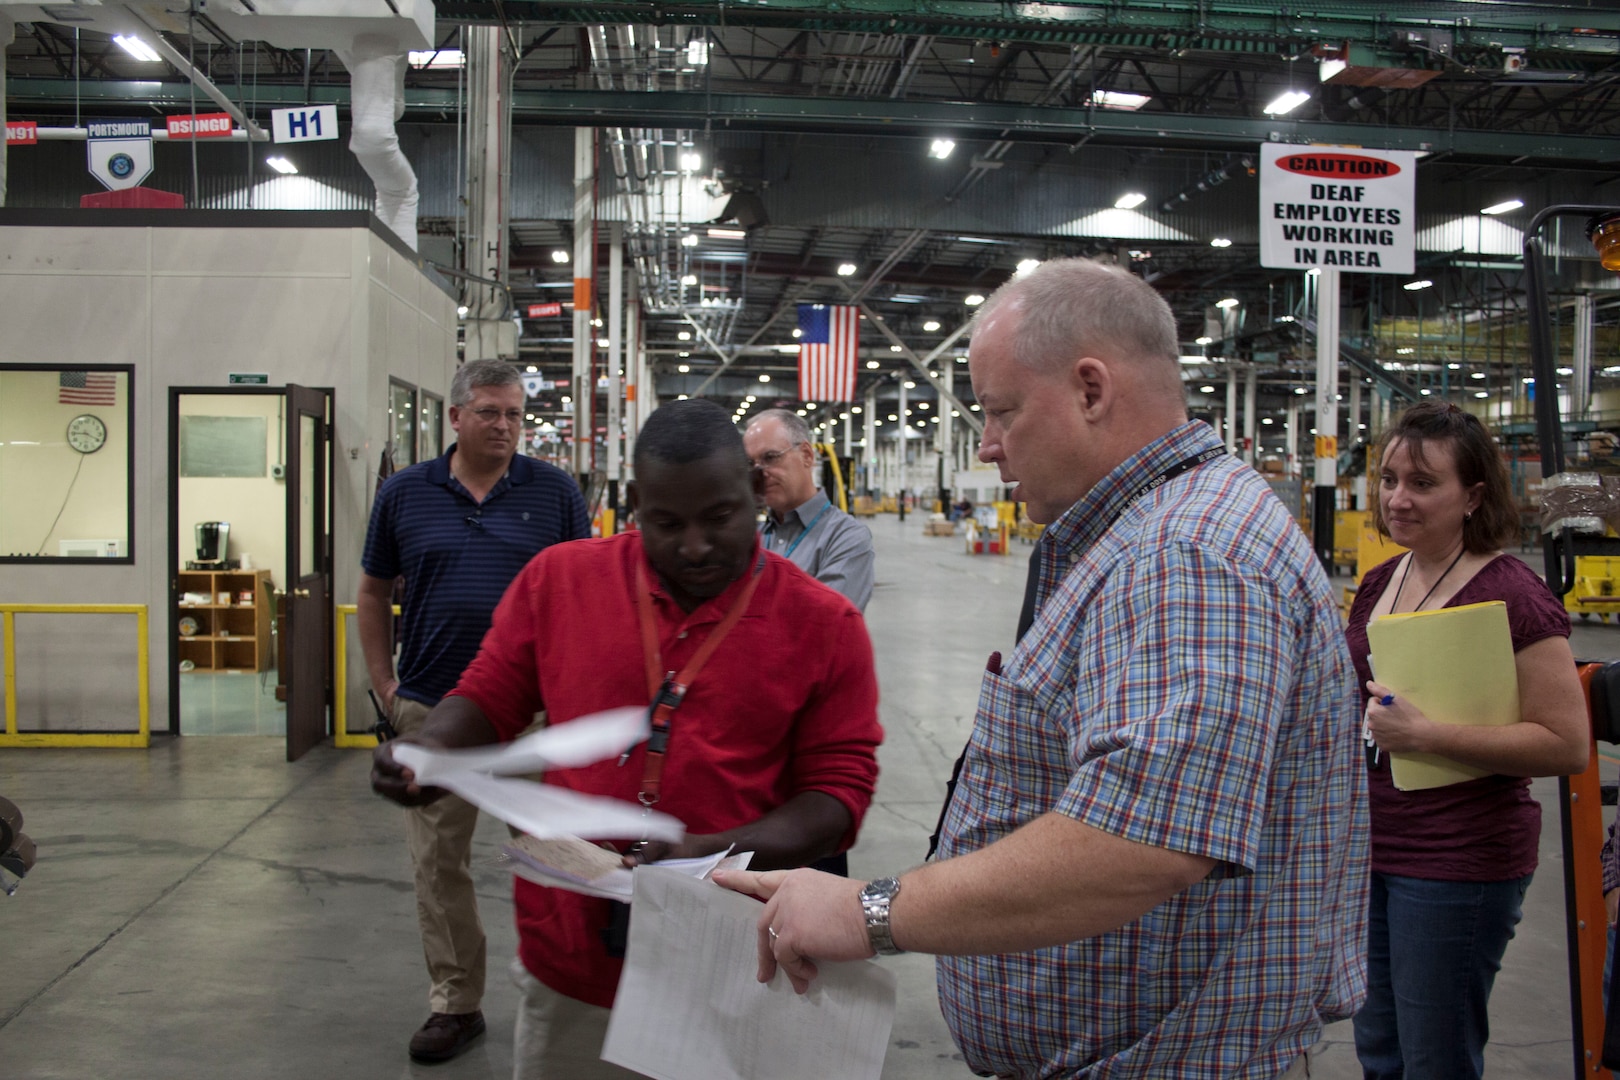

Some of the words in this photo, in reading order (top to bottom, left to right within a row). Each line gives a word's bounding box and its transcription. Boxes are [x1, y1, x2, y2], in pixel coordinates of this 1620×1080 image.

[88, 122, 150, 137] PORTSMOUTH
[288, 110, 322, 138] H1
[1289, 157, 1388, 175] CAUTION
[1311, 184, 1365, 202] DEAF
[1274, 203, 1401, 225] EMPLOYEES
[1282, 224, 1394, 246] WORKING
[1294, 248, 1317, 264] IN
[1323, 250, 1381, 267] AREA
